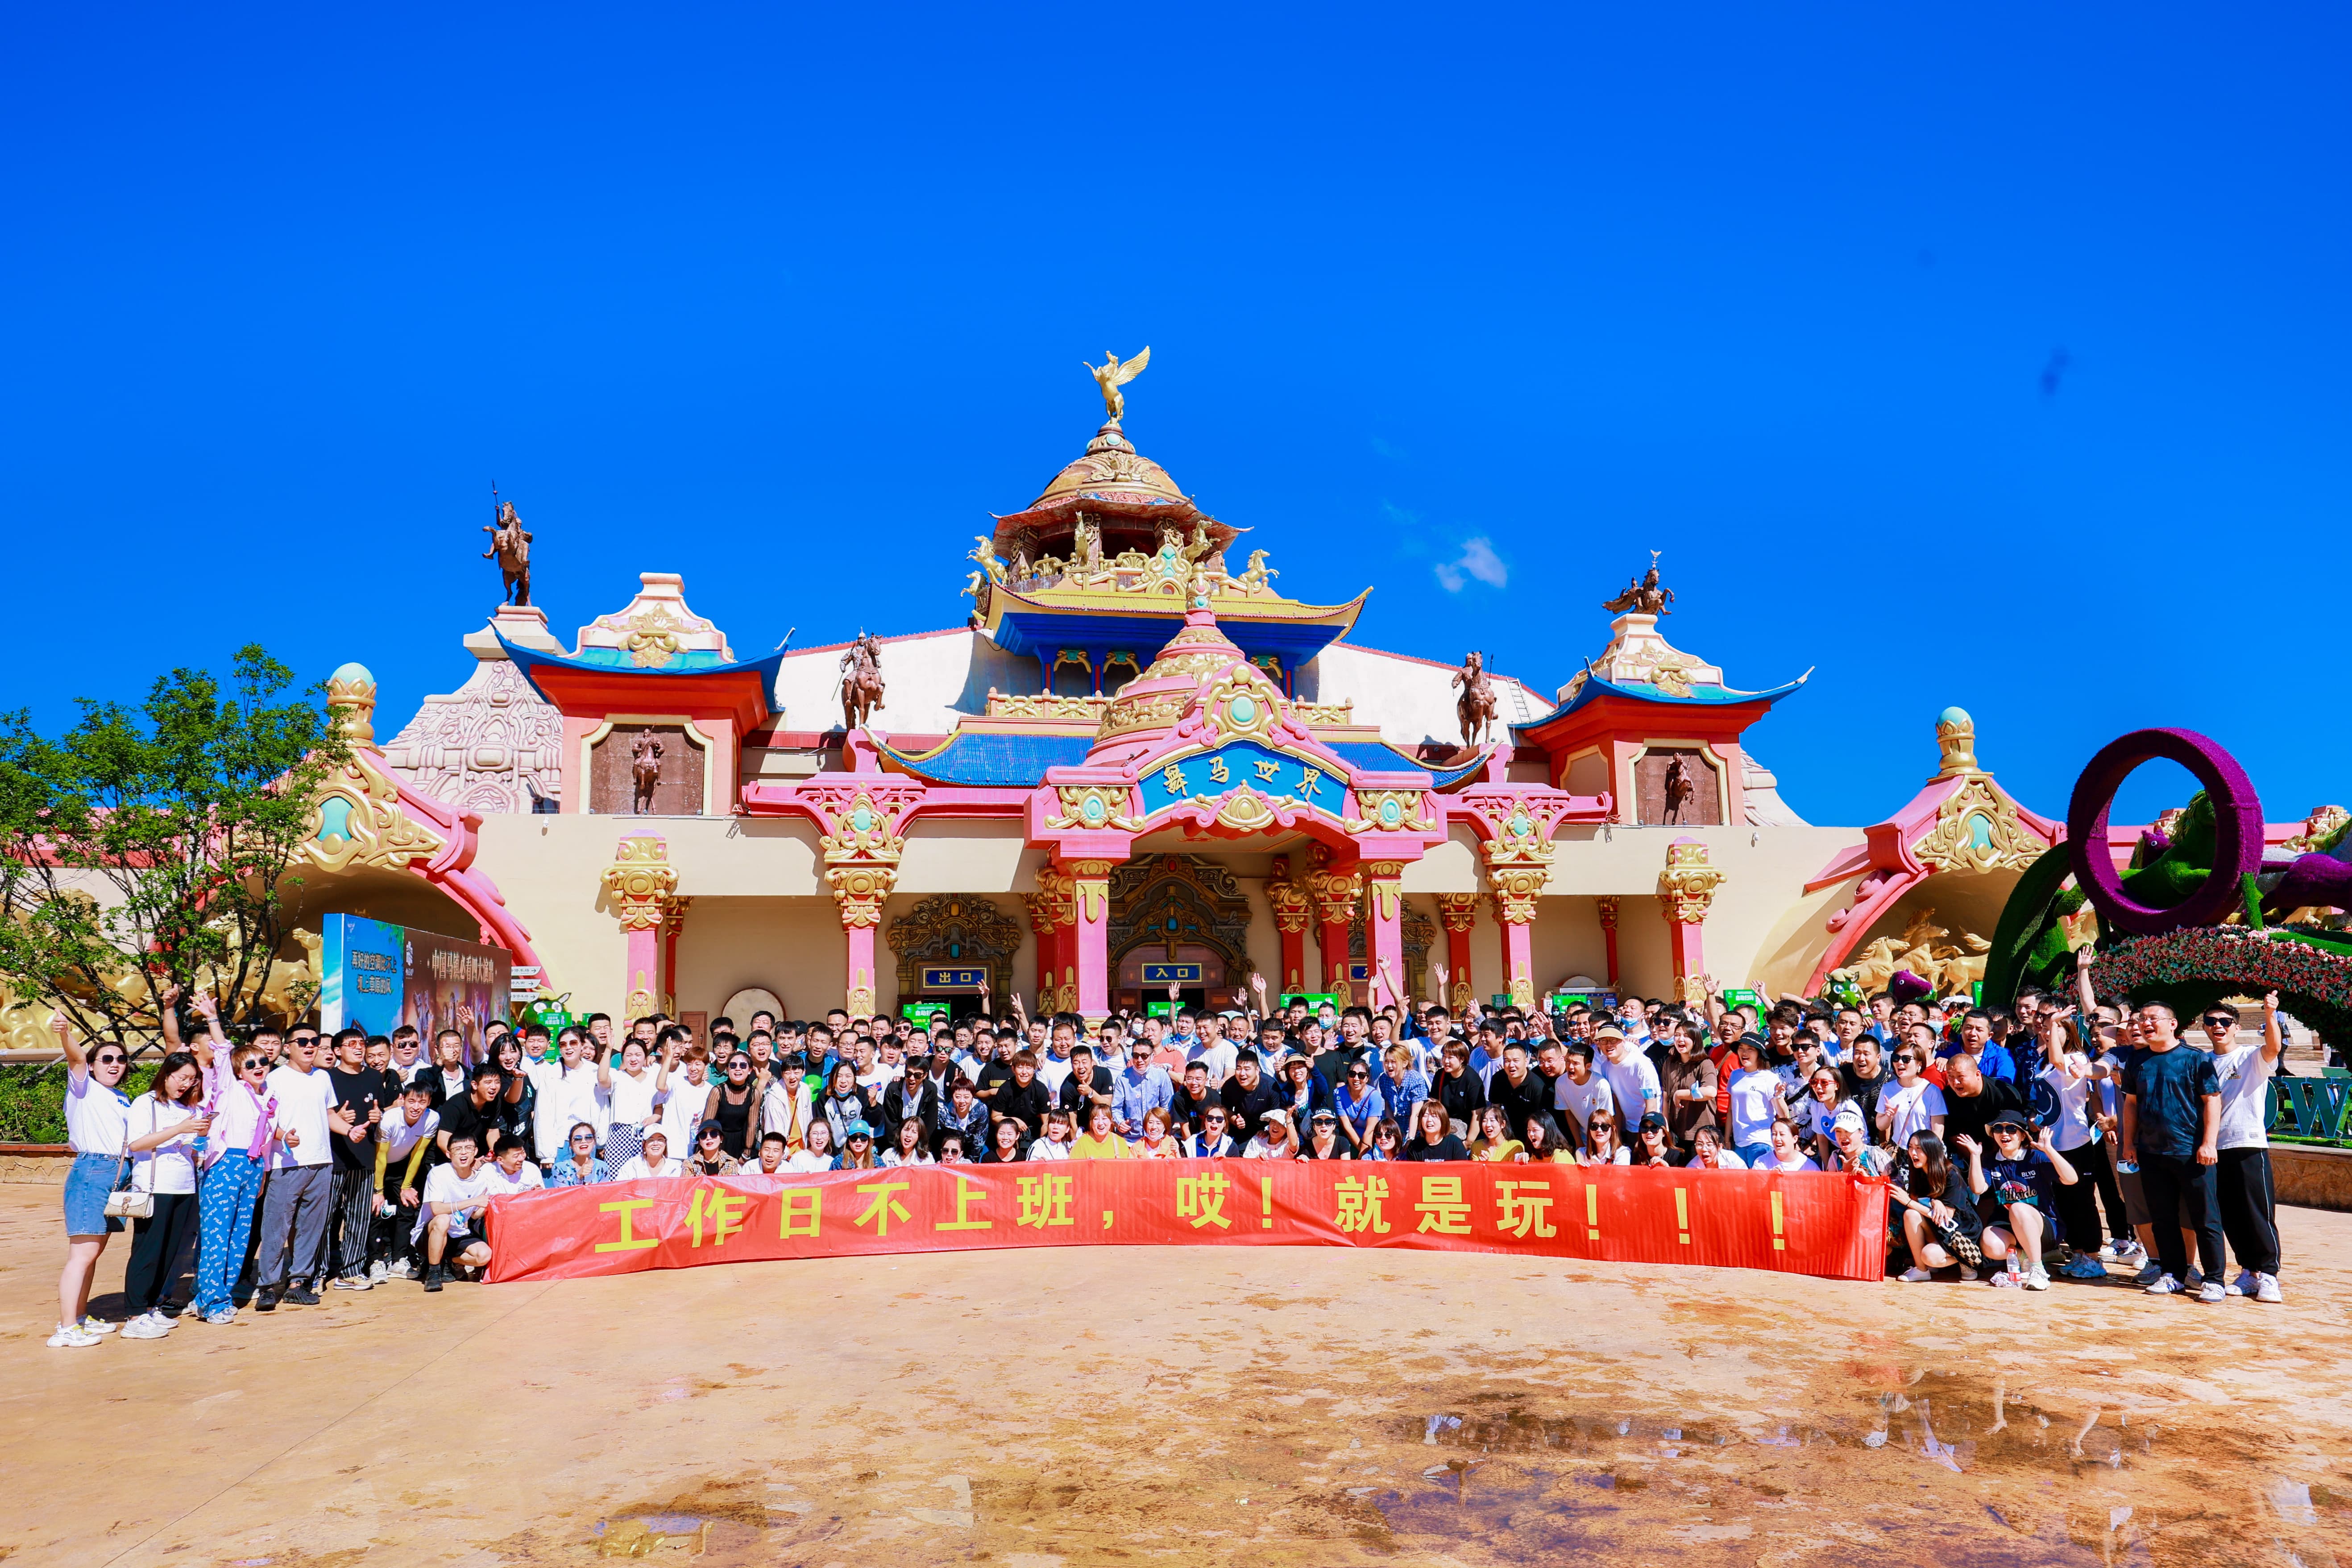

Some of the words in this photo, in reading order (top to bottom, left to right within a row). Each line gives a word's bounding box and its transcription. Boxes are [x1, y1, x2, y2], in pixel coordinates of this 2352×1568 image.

[1163, 756, 1322, 801] 舞马世界
[939, 972, 971, 983] 出口
[1156, 967, 1188, 978] 入口
[595, 1173, 1785, 1252] 工作日不上班，哎！就是玩！！！
